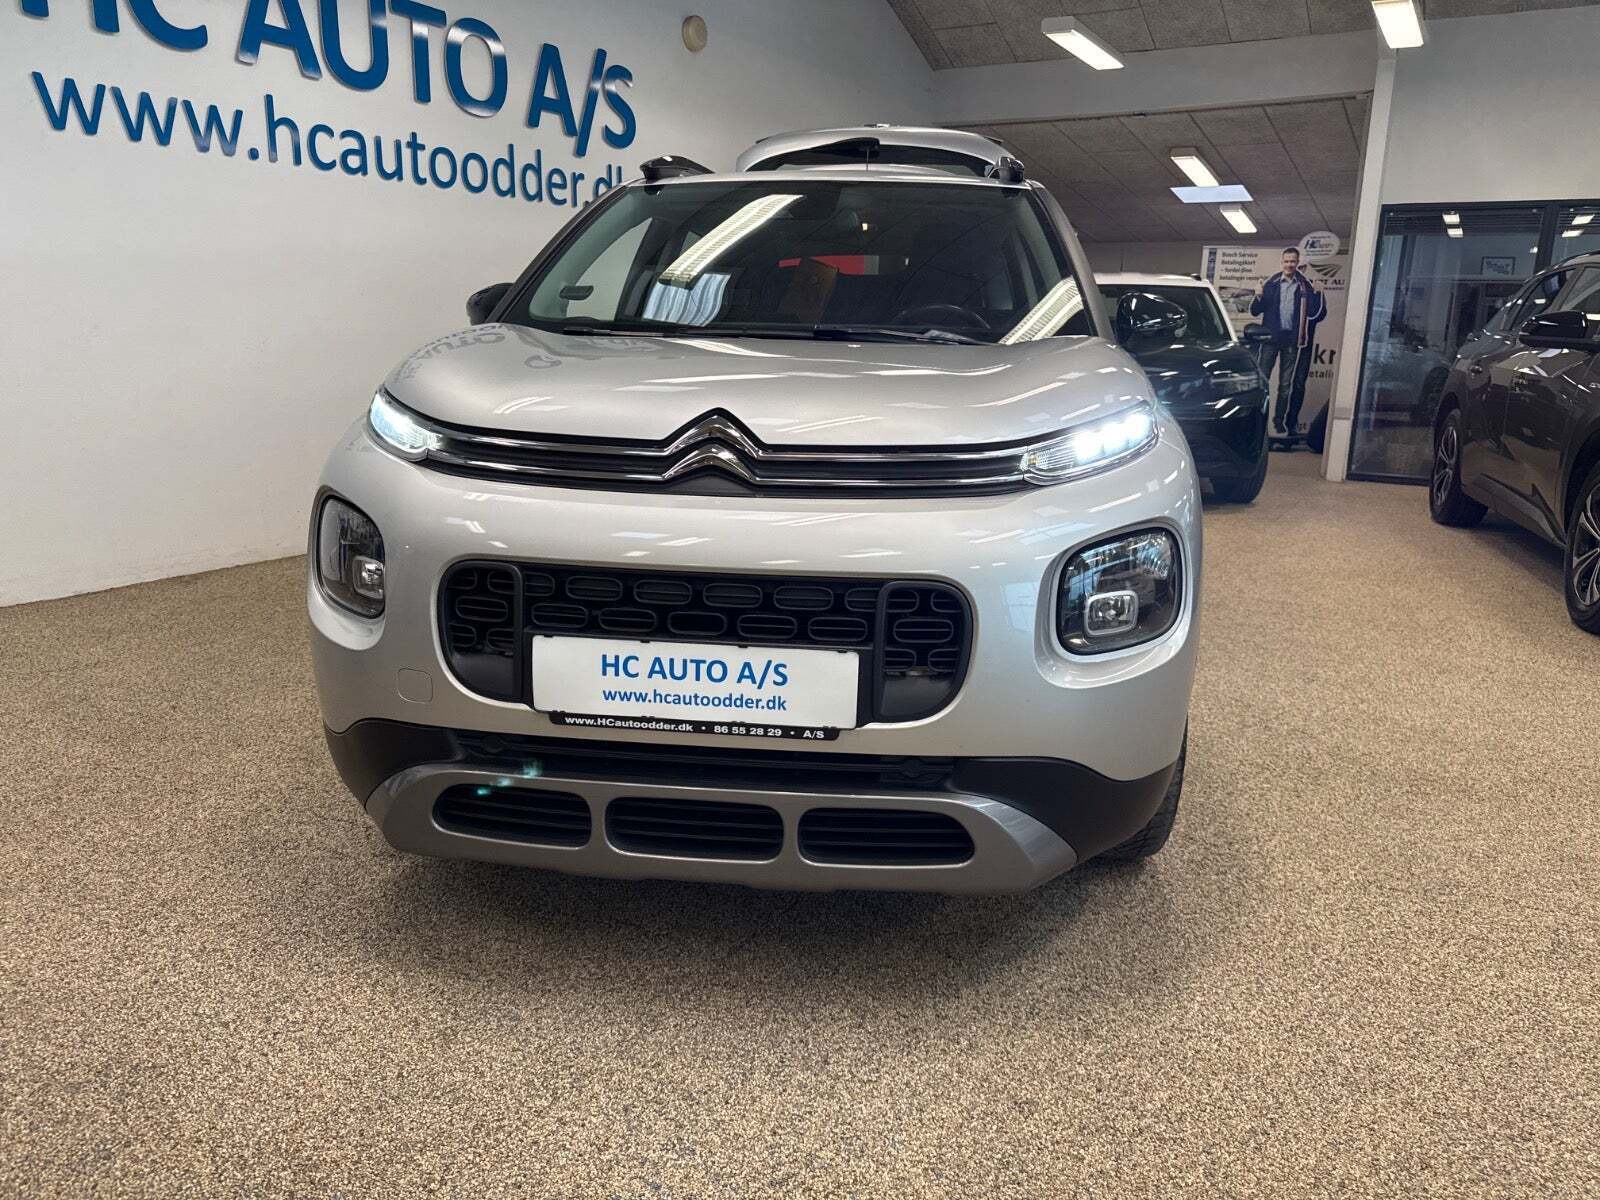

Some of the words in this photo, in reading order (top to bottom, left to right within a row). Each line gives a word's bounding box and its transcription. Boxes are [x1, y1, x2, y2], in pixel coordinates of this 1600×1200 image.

[236, 0, 508, 118] AUTO
[527, 42, 637, 157] A/S
[31, 71, 623, 208] www.hcautoodder.d
[601, 654, 640, 679] HC
[647, 656, 729, 684] AUTO
[736, 659, 789, 690] A/S
[602, 689, 787, 712] www.hcautoodder.dk
[564, 717, 694, 732] www.HCautoodder.dk
[713, 725, 729, 734] 86
[731, 726, 746, 735] 55
[750, 727, 765, 736] 28
[766, 728, 782, 737] 29
[803, 730, 825, 739] A/S
